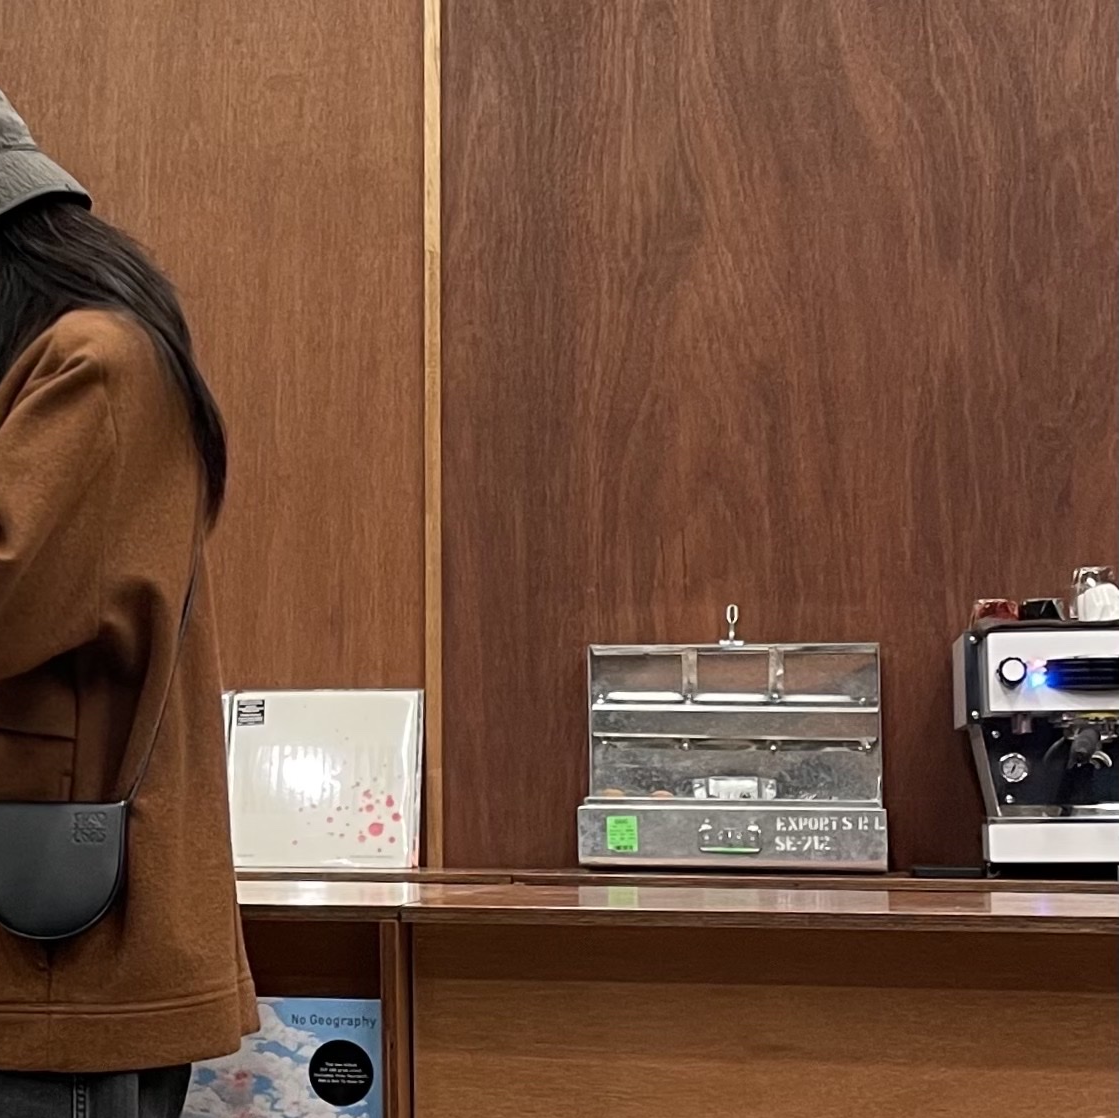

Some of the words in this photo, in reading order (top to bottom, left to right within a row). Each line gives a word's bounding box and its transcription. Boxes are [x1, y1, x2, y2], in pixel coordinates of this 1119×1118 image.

[776, 816, 839, 831] EXPORT
[291, 1014, 306, 1025] No
[309, 1014, 377, 1028] Geography
